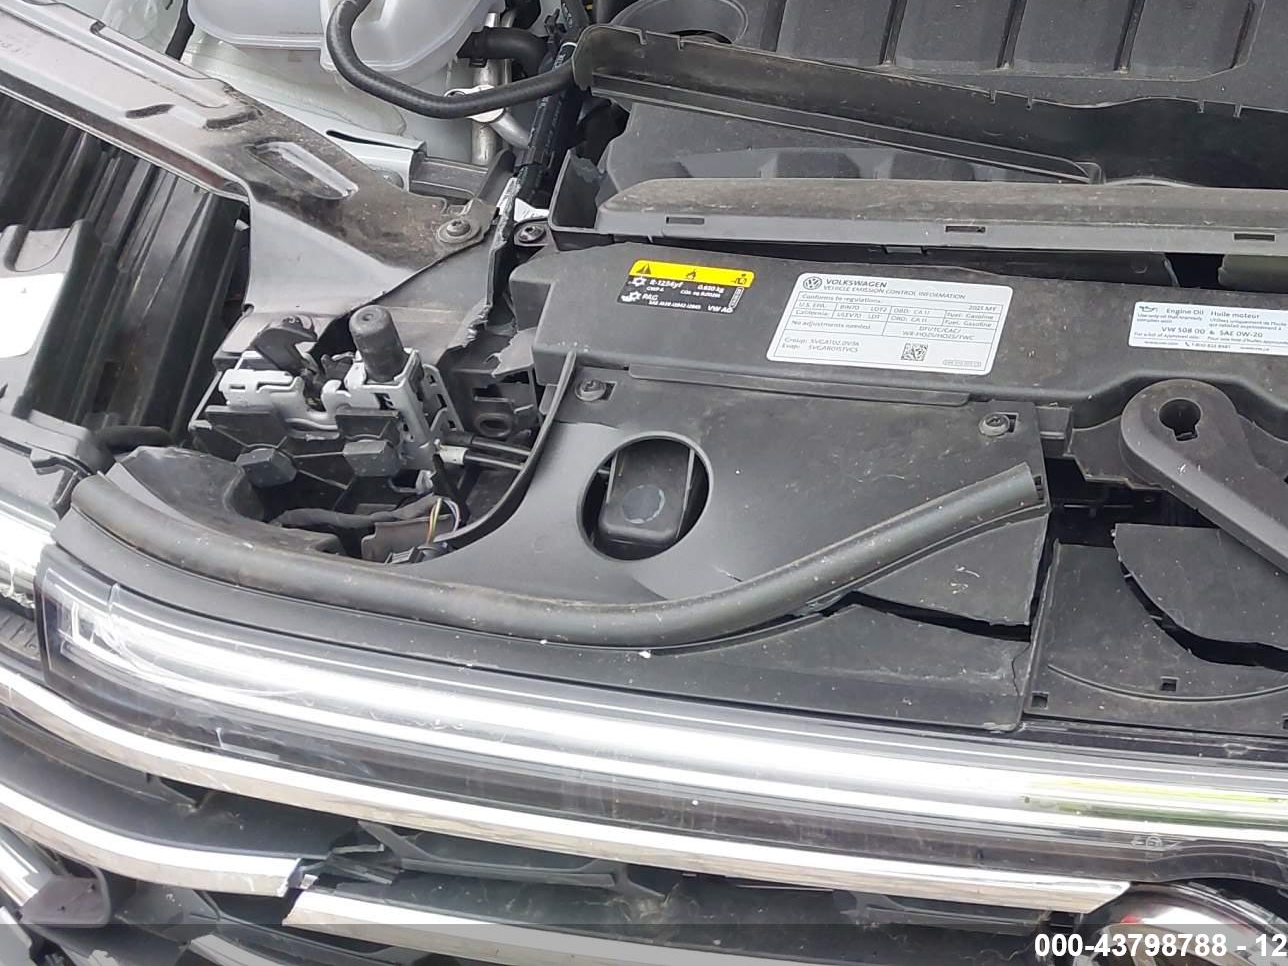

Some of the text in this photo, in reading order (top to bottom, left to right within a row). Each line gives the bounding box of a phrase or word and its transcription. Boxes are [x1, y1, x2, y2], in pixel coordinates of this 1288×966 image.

[826, 278, 888, 288] VOLKSWAGEN
[852, 286, 885, 294] EMISSION
[886, 288, 916, 296] CONTROL
[918, 290, 966, 300] INFORMATION
[1166, 308, 1192, 316] Engine
